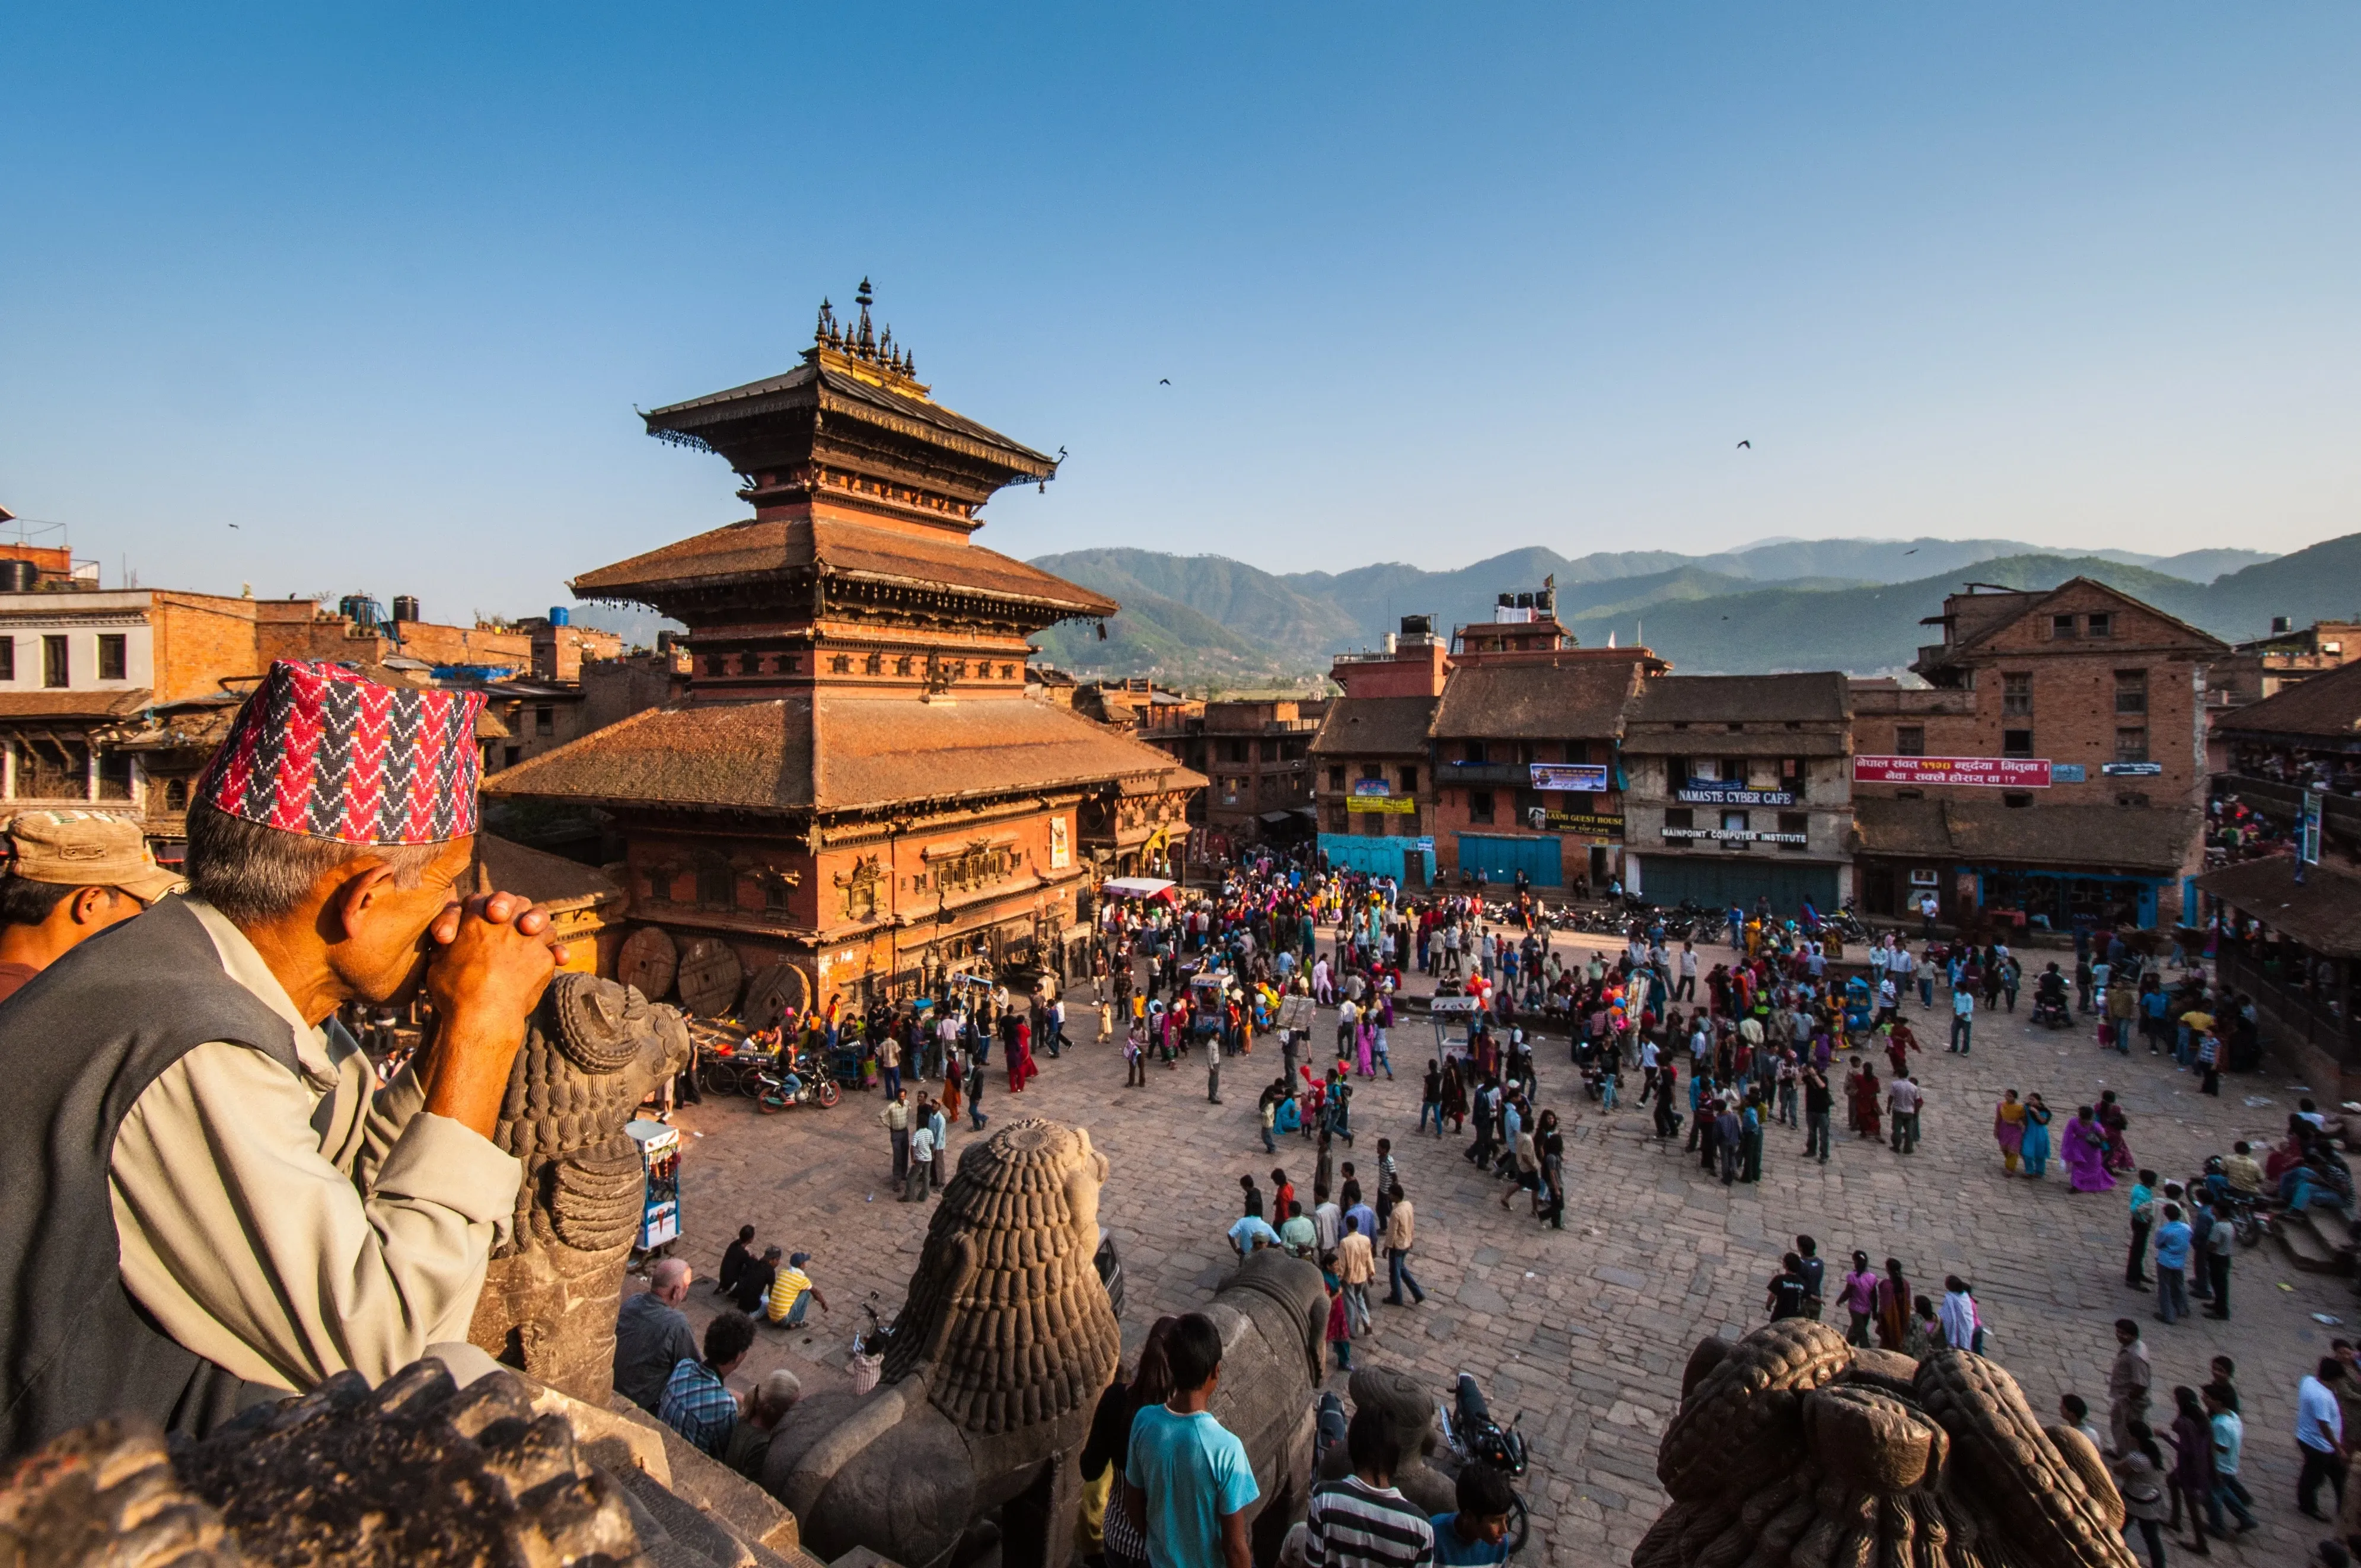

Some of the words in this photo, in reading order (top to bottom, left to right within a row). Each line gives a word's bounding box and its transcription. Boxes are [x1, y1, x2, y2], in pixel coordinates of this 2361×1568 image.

[1857, 758, 1888, 768] नेपाल
[1892, 759, 1919, 770] संवत्
[1678, 790, 1723, 802] NAMASTE
[1727, 792, 1760, 804] CYBER
[1763, 793, 1791, 804] CAFE
[1570, 815, 1595, 823] GUEST
[1597, 817, 1624, 826] HOUSE
[1662, 828, 1707, 838] MAINPOINT
[1710, 830, 1757, 841] COMPUTER
[1761, 833, 1807, 843] INSTITUTE
